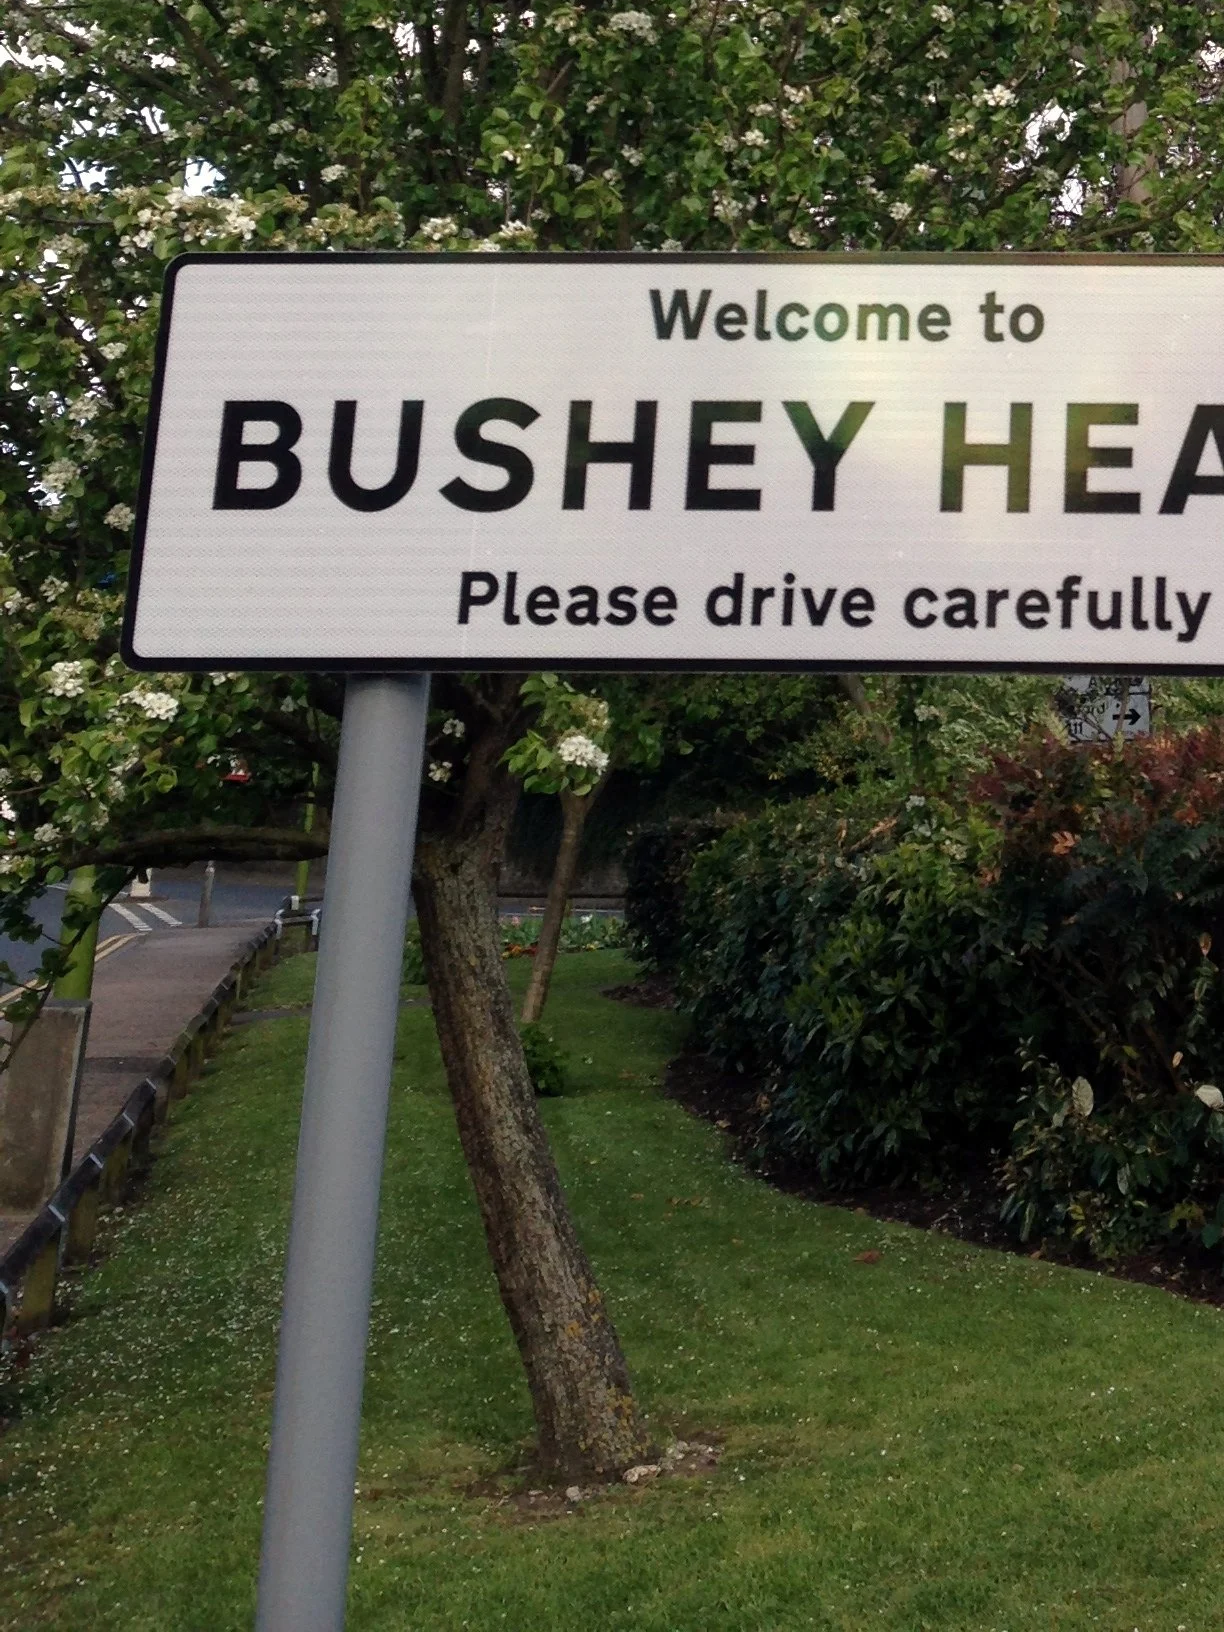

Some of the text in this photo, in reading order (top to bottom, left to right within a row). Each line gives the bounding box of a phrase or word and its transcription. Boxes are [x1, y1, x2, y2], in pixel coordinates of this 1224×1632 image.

[648, 288, 1045, 343] Welcome to
[211, 398, 876, 514] BUSHEY
[456, 570, 1213, 644] Please drive carefully
